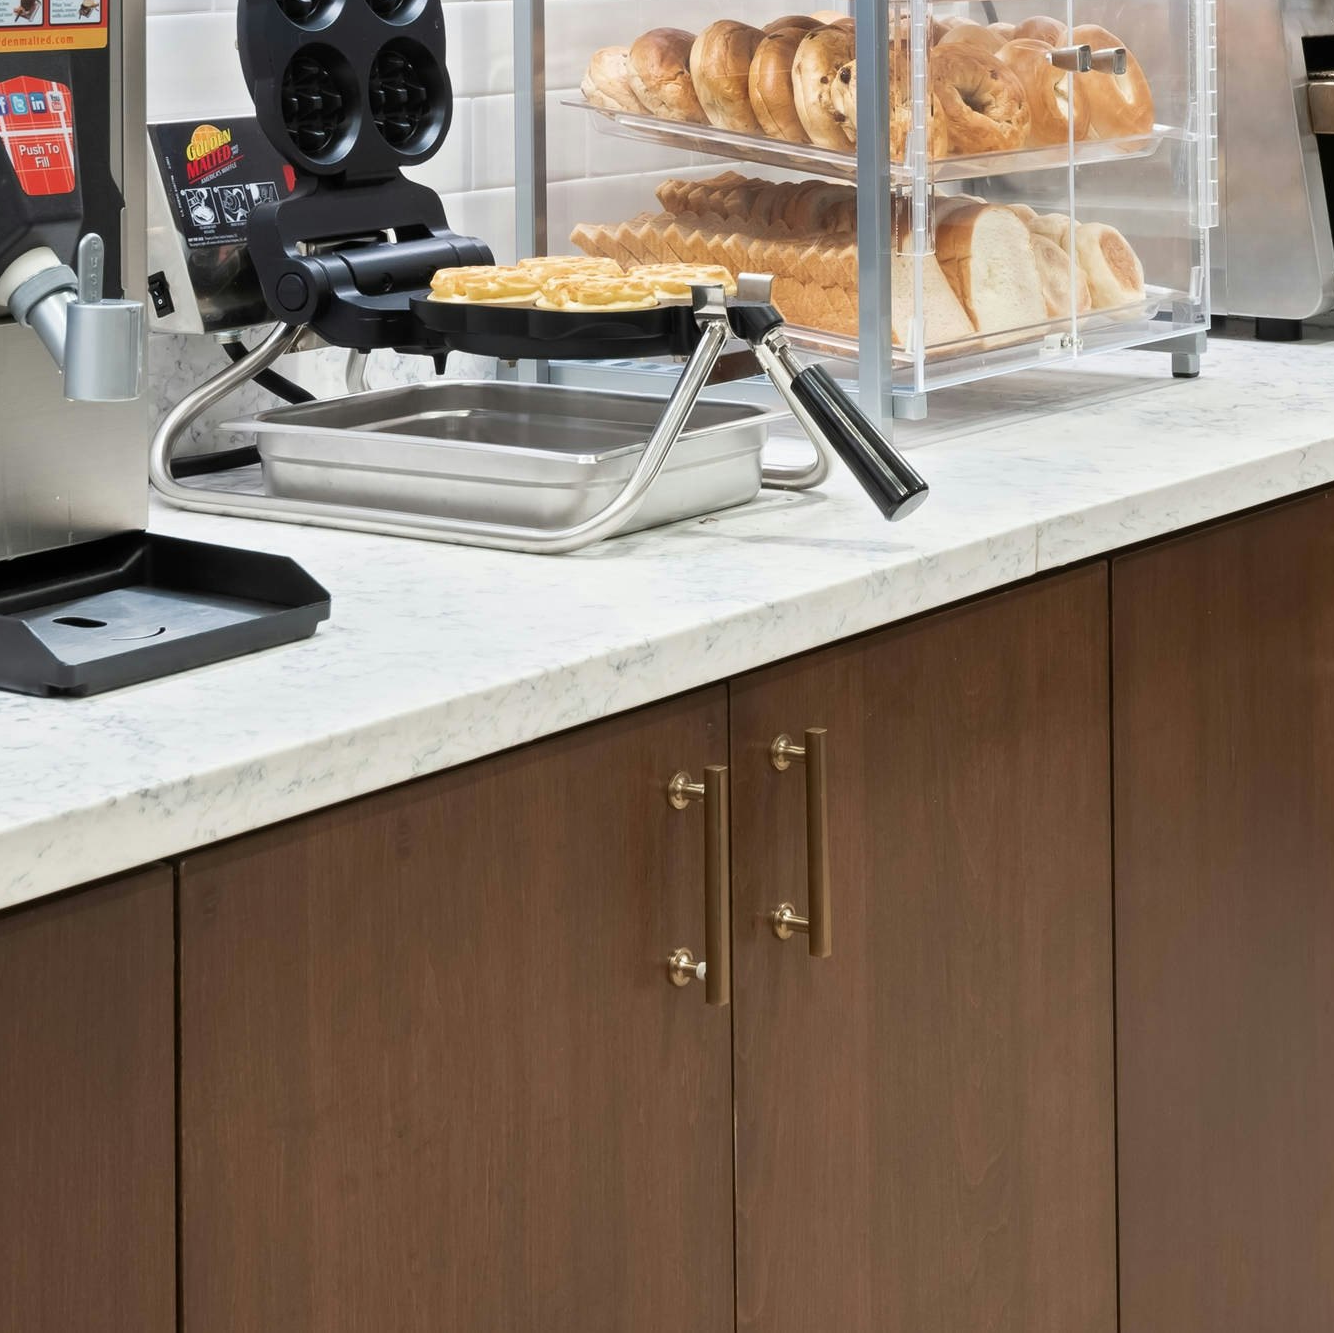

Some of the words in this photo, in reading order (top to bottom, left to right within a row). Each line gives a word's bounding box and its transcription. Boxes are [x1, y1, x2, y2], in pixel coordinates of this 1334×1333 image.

[18, 144, 44, 156] Push
[46, 143, 60, 154] To
[186, 128, 231, 161] GOLDEN
[35, 157, 50, 168] Fill
[186, 145, 231, 179] MALTED
